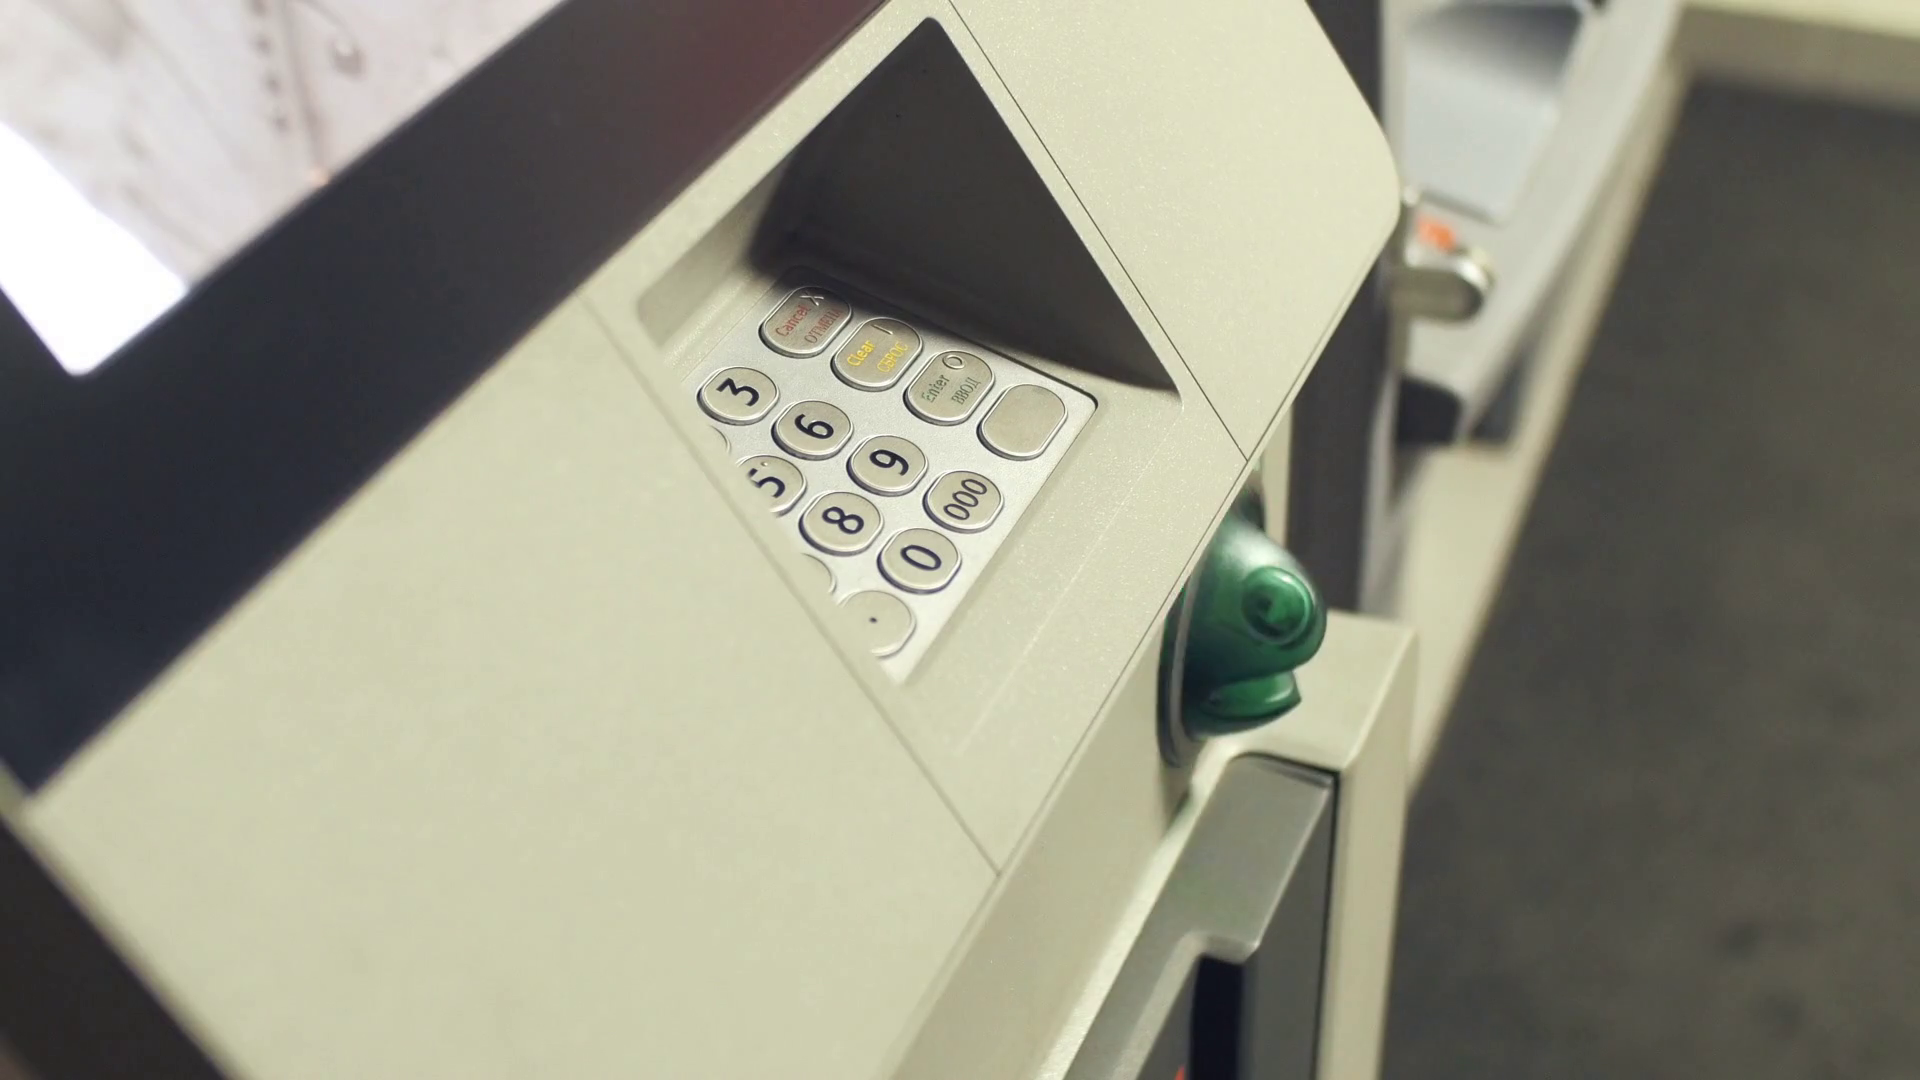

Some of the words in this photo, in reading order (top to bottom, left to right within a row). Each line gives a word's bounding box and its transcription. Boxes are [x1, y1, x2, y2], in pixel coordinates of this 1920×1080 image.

[775, 304, 811, 337] Cancel
[847, 339, 876, 367] Clear
[877, 341, 909, 373] СБРОС
[716, 377, 760, 407] 3
[921, 373, 950, 403] Enter
[951, 376, 982, 405] ВВОД
[794, 413, 835, 440] 6
[869, 449, 909, 476] 9
[748, 468, 786, 499] 5
[943, 478, 988, 521] 000
[822, 506, 865, 535] 8
[900, 544, 942, 571] 0
